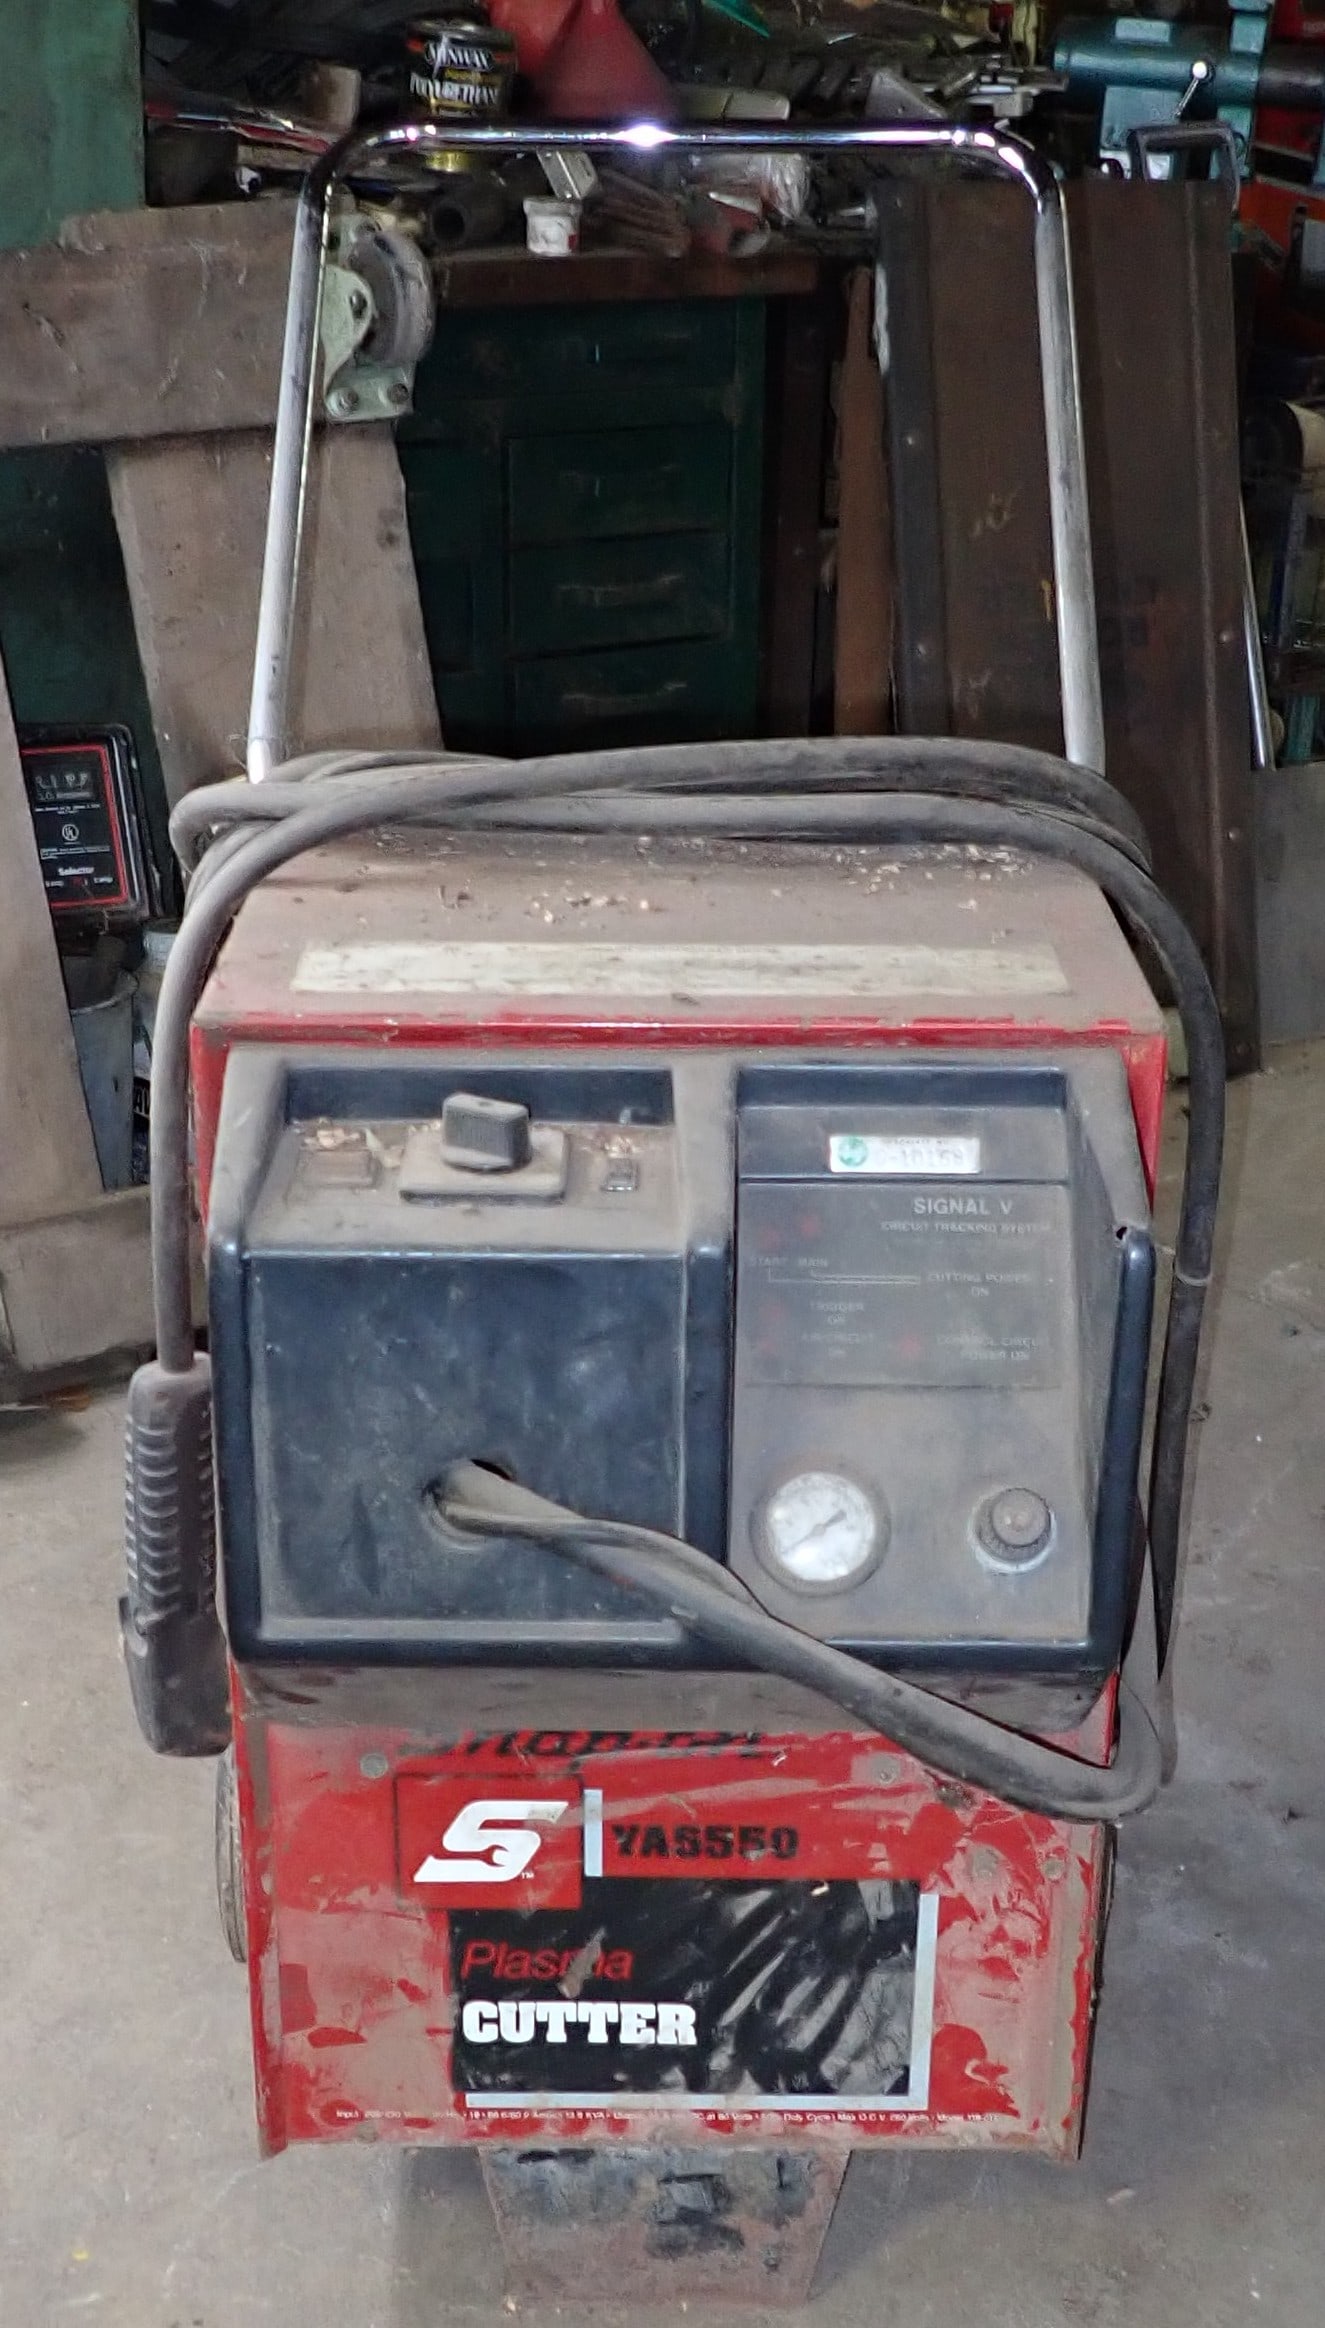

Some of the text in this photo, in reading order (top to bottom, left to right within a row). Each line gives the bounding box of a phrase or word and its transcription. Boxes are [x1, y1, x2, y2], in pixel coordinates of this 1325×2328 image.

[914, 1197, 1013, 1215] SIGNAL V
[935, 1221, 997, 1233] TRACKING
[970, 1285, 990, 1297] ON
[611, 1823, 799, 1860] YAS550
[462, 2001, 697, 2046] CUTTER
